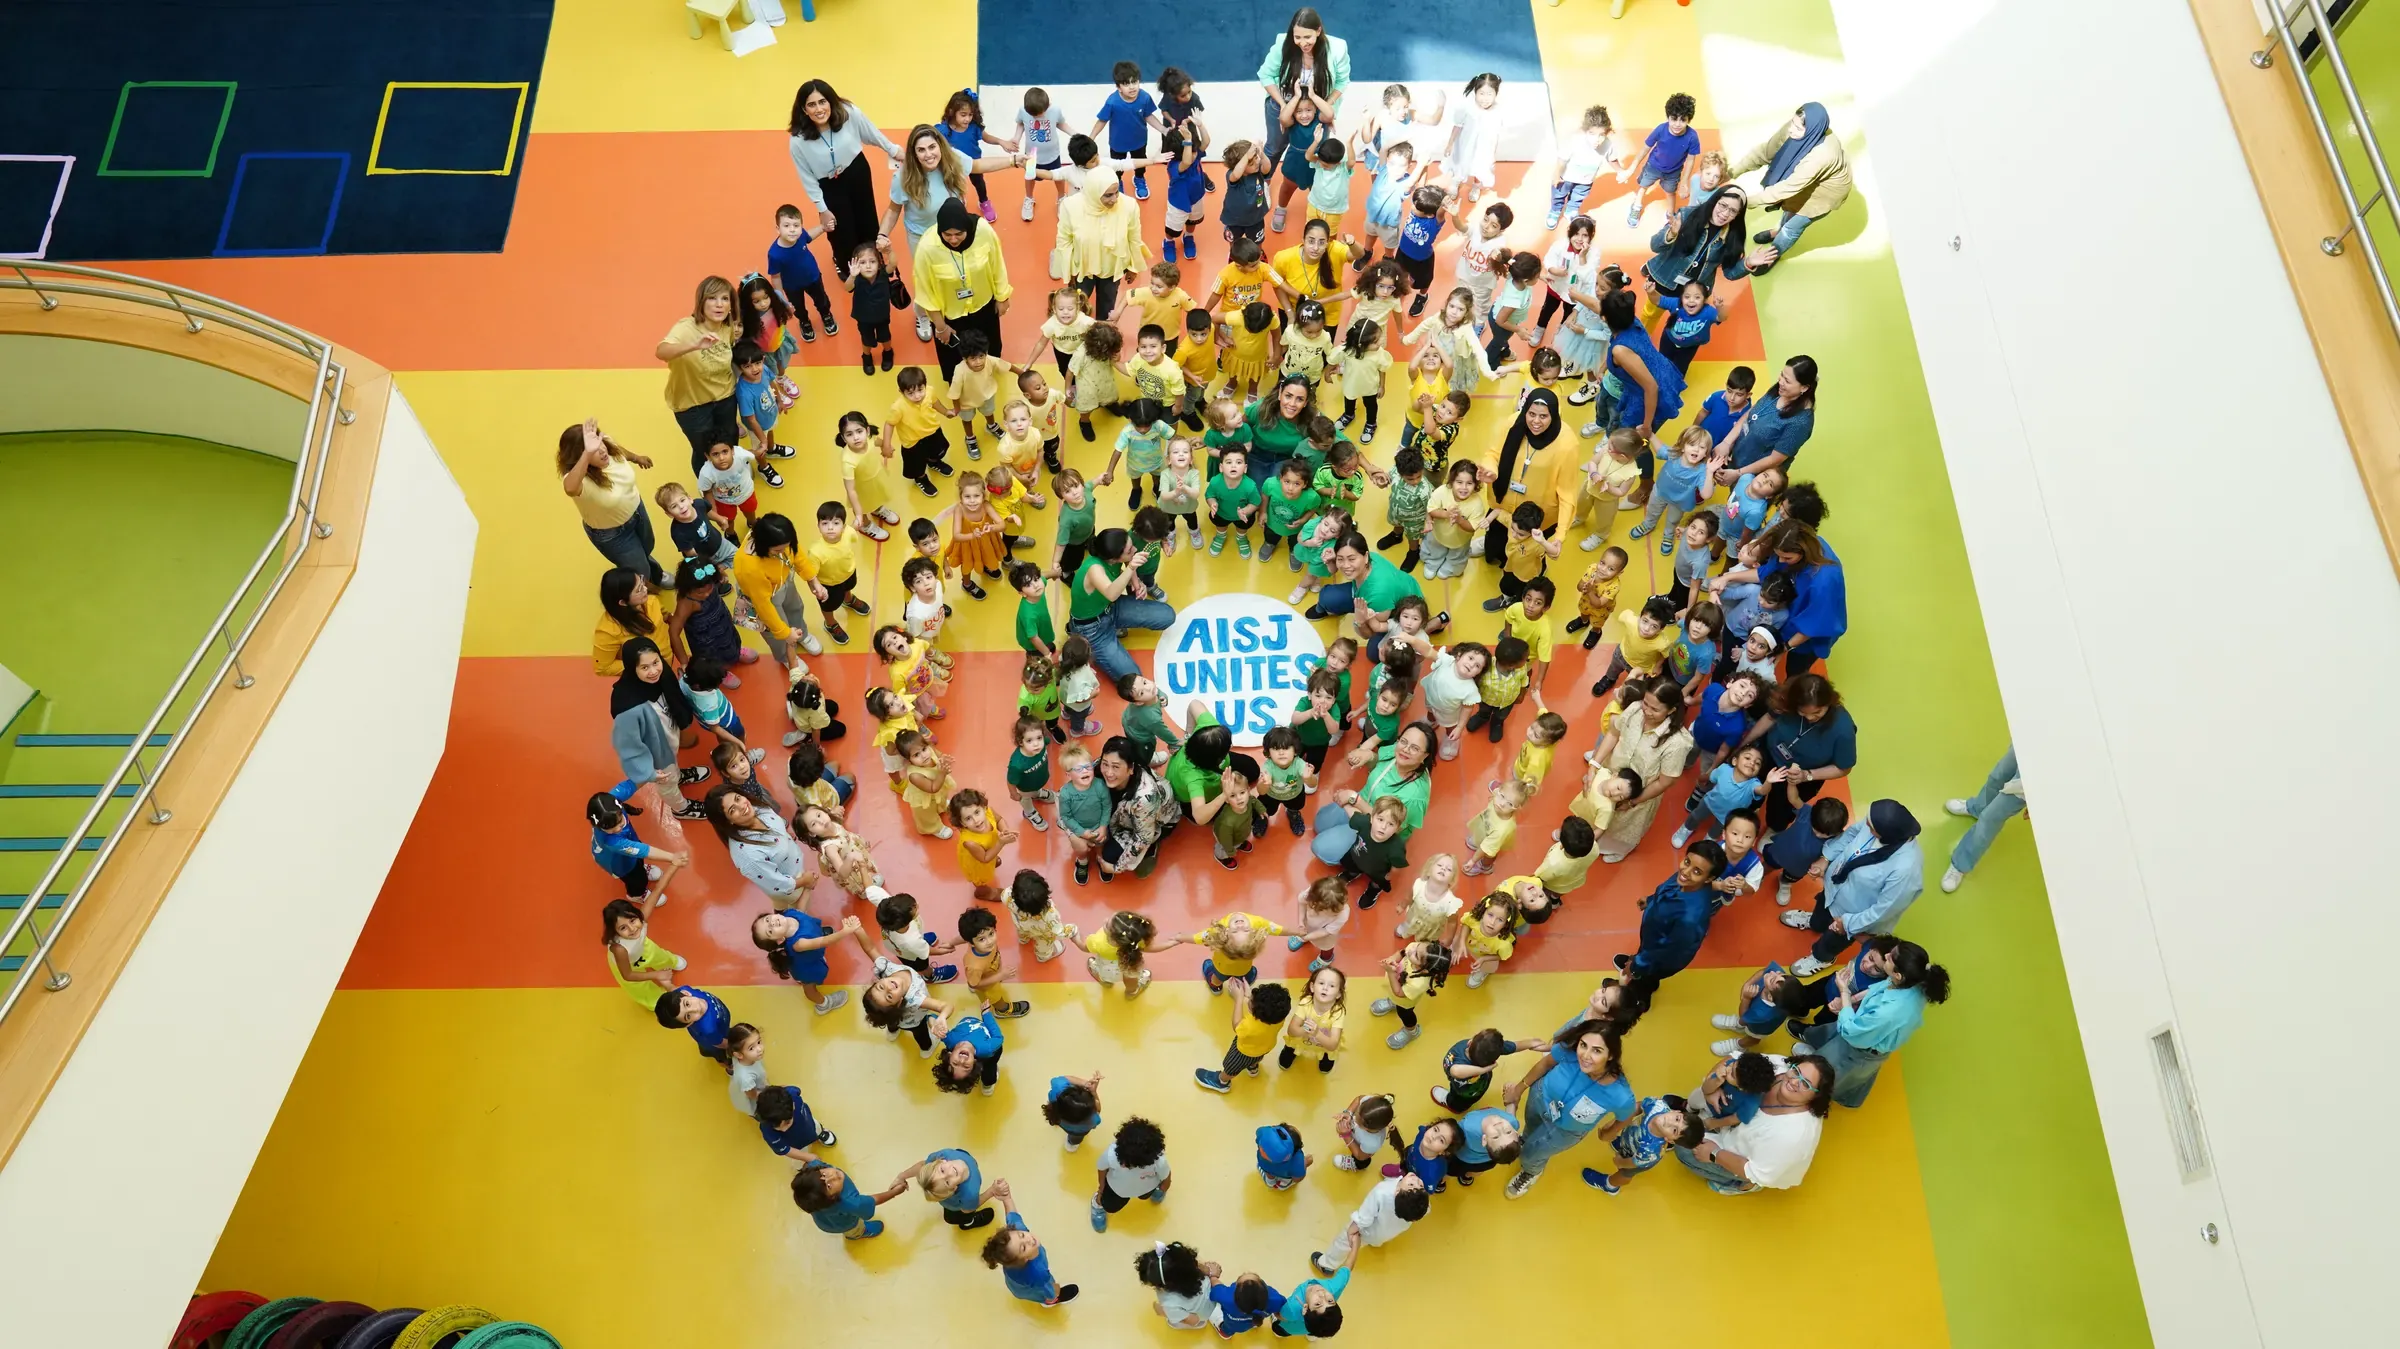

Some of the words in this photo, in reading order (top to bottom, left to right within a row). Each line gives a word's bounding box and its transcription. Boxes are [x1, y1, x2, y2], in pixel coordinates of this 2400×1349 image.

[1232, 283, 1262, 293] ADIDAS
[1673, 319, 1701, 333] NIKE
[1176, 614, 1292, 653] AISJ
[1167, 653, 1319, 695] UNITES
[1214, 696, 1277, 735] US
